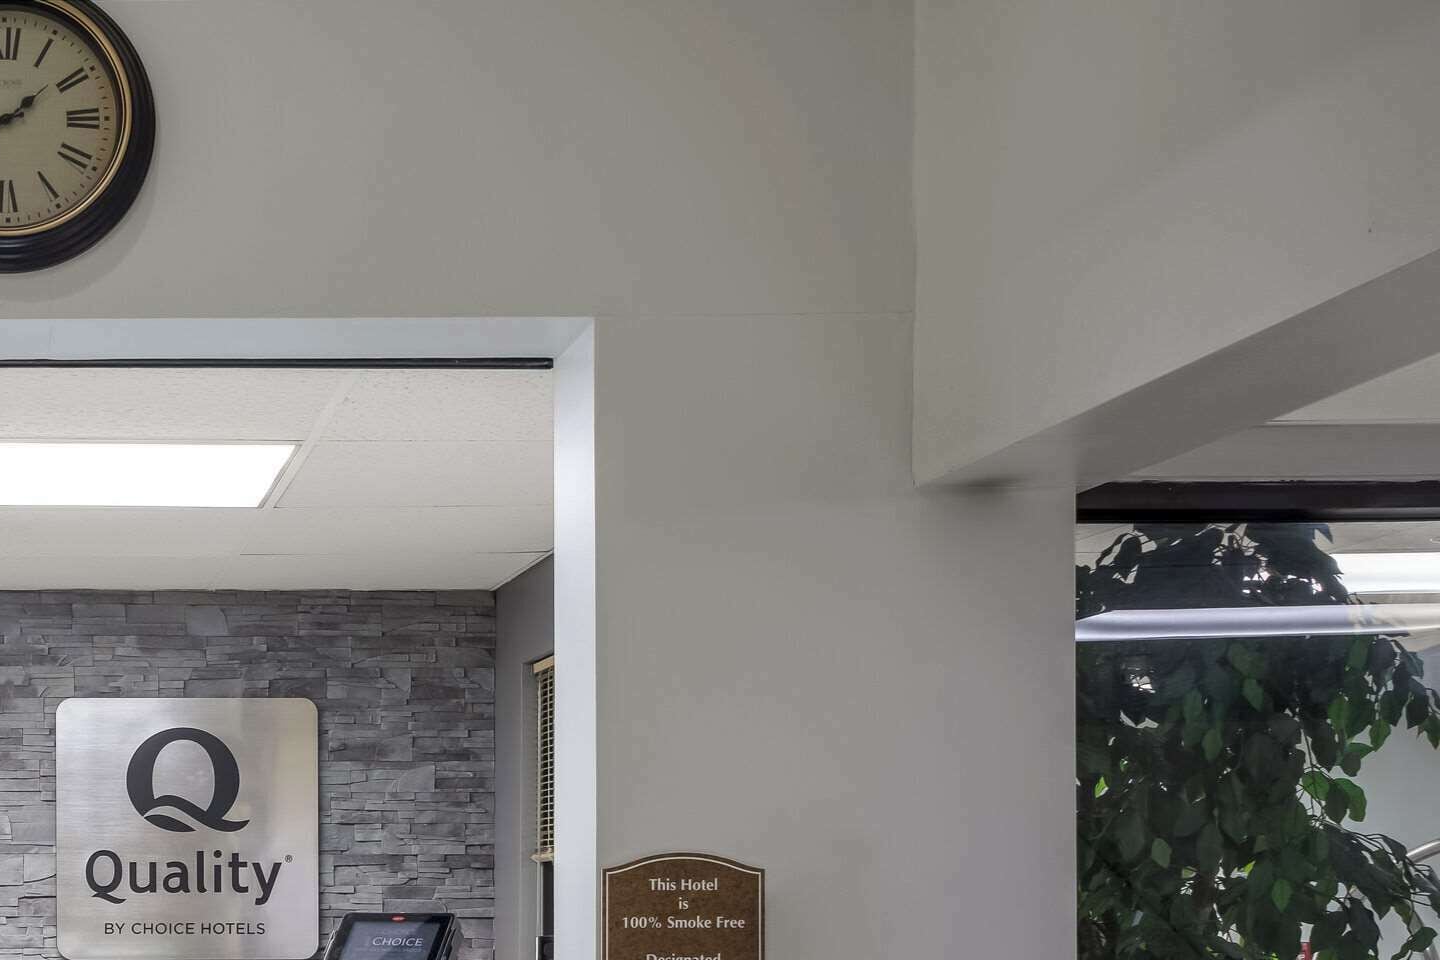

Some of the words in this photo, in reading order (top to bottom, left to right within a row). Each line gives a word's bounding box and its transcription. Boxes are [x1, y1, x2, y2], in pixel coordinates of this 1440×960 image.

[34, 38, 54, 67] I
[56, 67, 89, 93] II
[67, 108, 99, 129] III
[37, 171, 59, 201] V
[126, 727, 250, 832] Q
[648, 878, 677, 891] This
[681, 878, 718, 891] Hotel
[678, 897, 689, 910] is
[104, 922, 125, 935] BY
[131, 922, 195, 935] CHOICE
[201, 922, 265, 935] HOTELS
[622, 917, 662, 929] 100%
[667, 916, 711, 929] Smoke
[716, 917, 745, 929] Free
[372, 937, 424, 946] CHOICE
